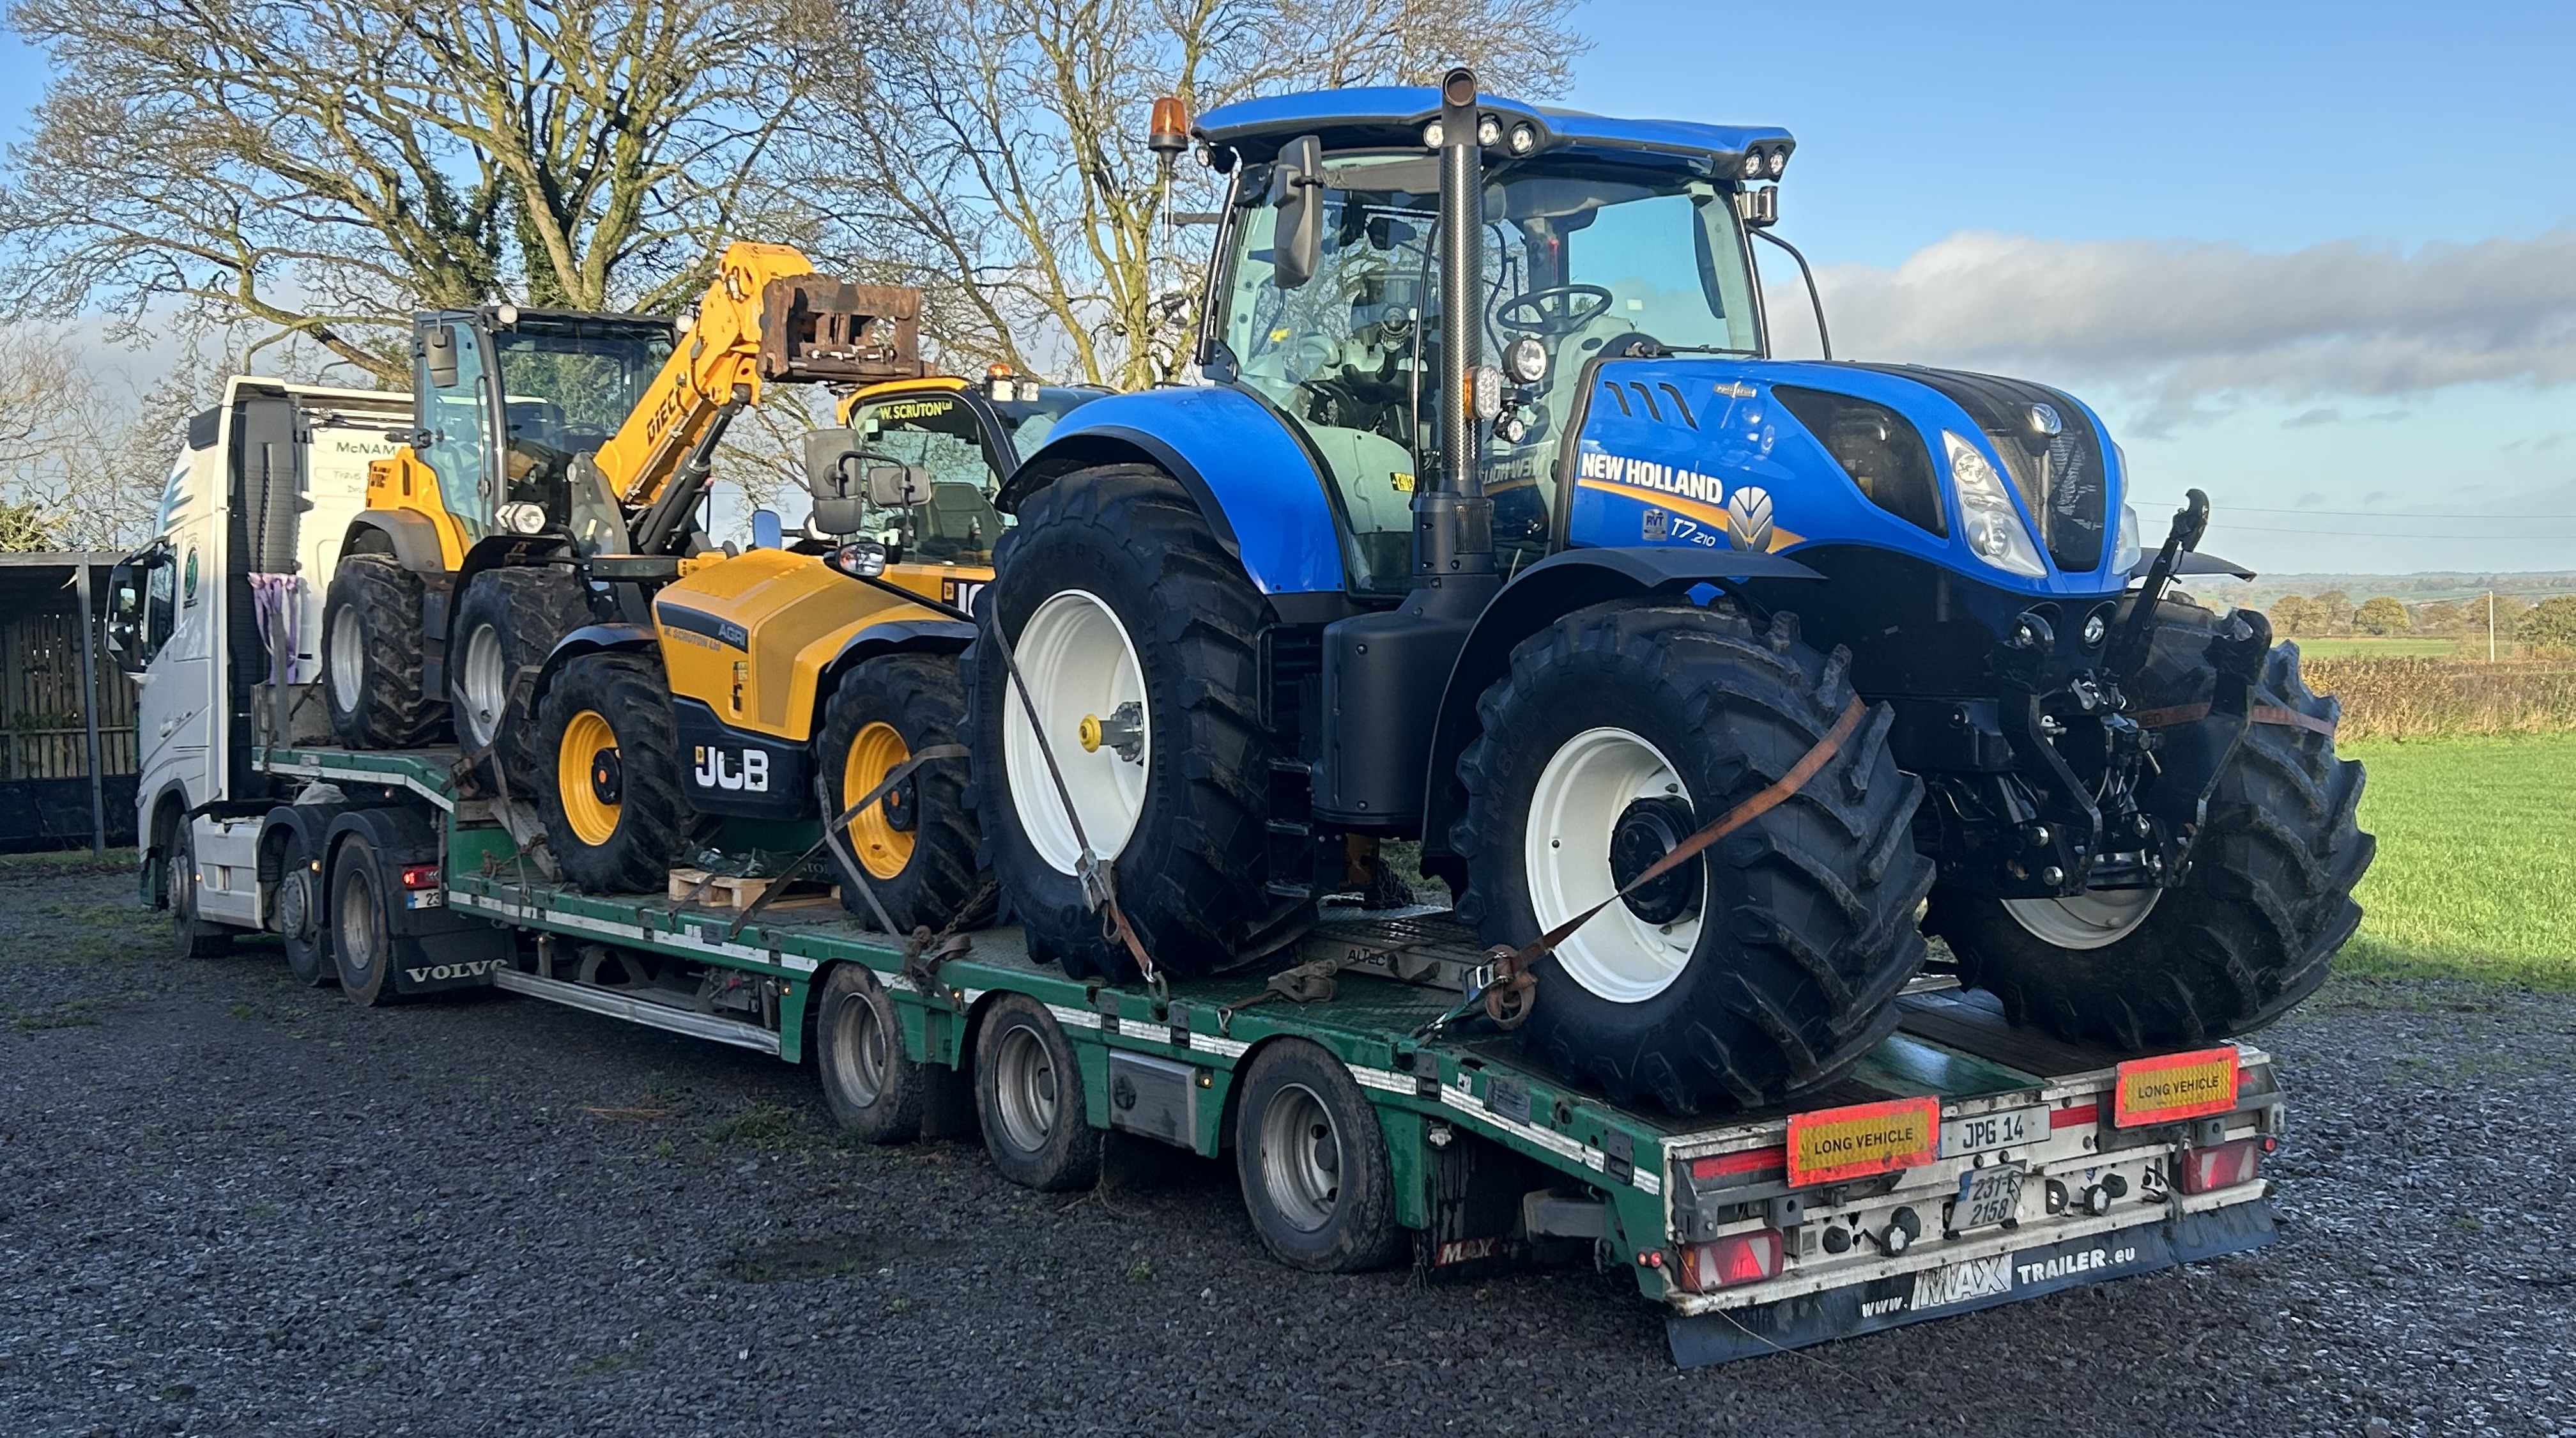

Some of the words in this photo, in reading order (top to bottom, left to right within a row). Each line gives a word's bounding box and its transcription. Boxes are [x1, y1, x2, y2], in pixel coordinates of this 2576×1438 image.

[893, 401, 942, 419] SCRUTON
[336, 442, 397, 455] McNAM
[1581, 452, 1625, 481] NEW
[1626, 458, 1723, 504] HOLLAND
[718, 623, 746, 646] AGRI
[695, 746, 769, 792] JCB
[405, 959, 508, 982] VOLVO
[2138, 1083, 2171, 1099] LONG
[2173, 1076, 2220, 1094] VEHICLE
[1814, 1137, 1853, 1155] LONG
[1855, 1127, 1914, 1148] VEHICLE
[1963, 1119, 1997, 1148] JPG
[2003, 1114, 2024, 1142] 14
[1970, 1198, 2009, 1226] 2158
[1919, 1255, 2009, 1307] MAX
